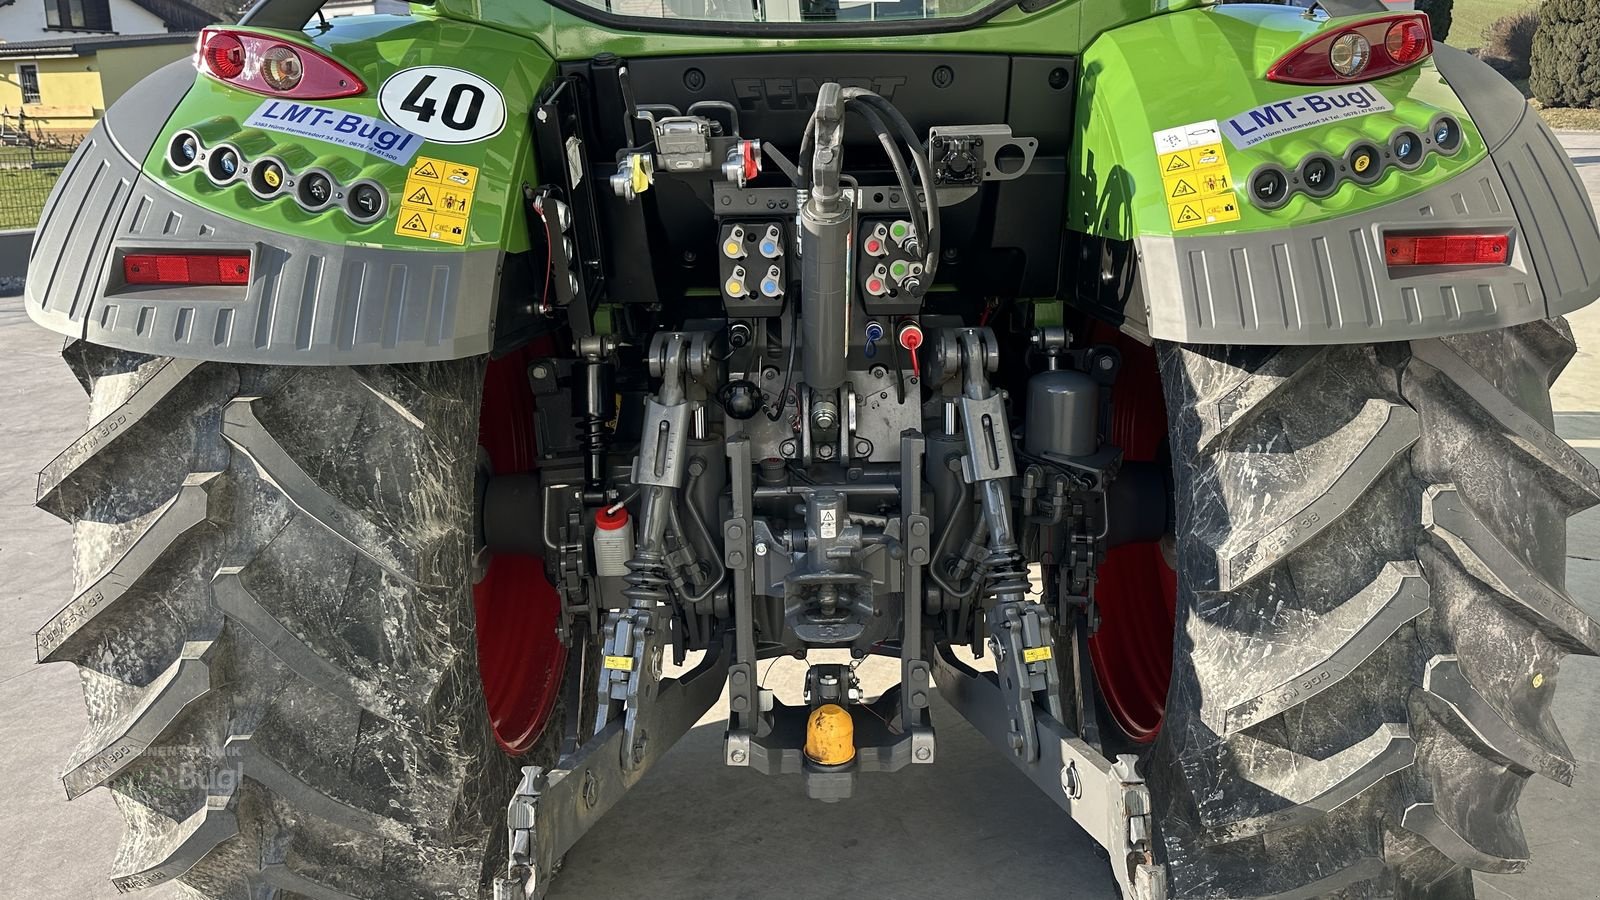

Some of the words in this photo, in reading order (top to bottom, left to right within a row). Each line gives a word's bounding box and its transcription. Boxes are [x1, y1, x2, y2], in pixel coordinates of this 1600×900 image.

[261, 101, 414, 152] LMT-Bugl
[400, 74, 485, 131] 40
[1229, 86, 1377, 137] LMT-Bugl
[101, 415, 127, 437] 800
[1302, 670, 1331, 690] 800
